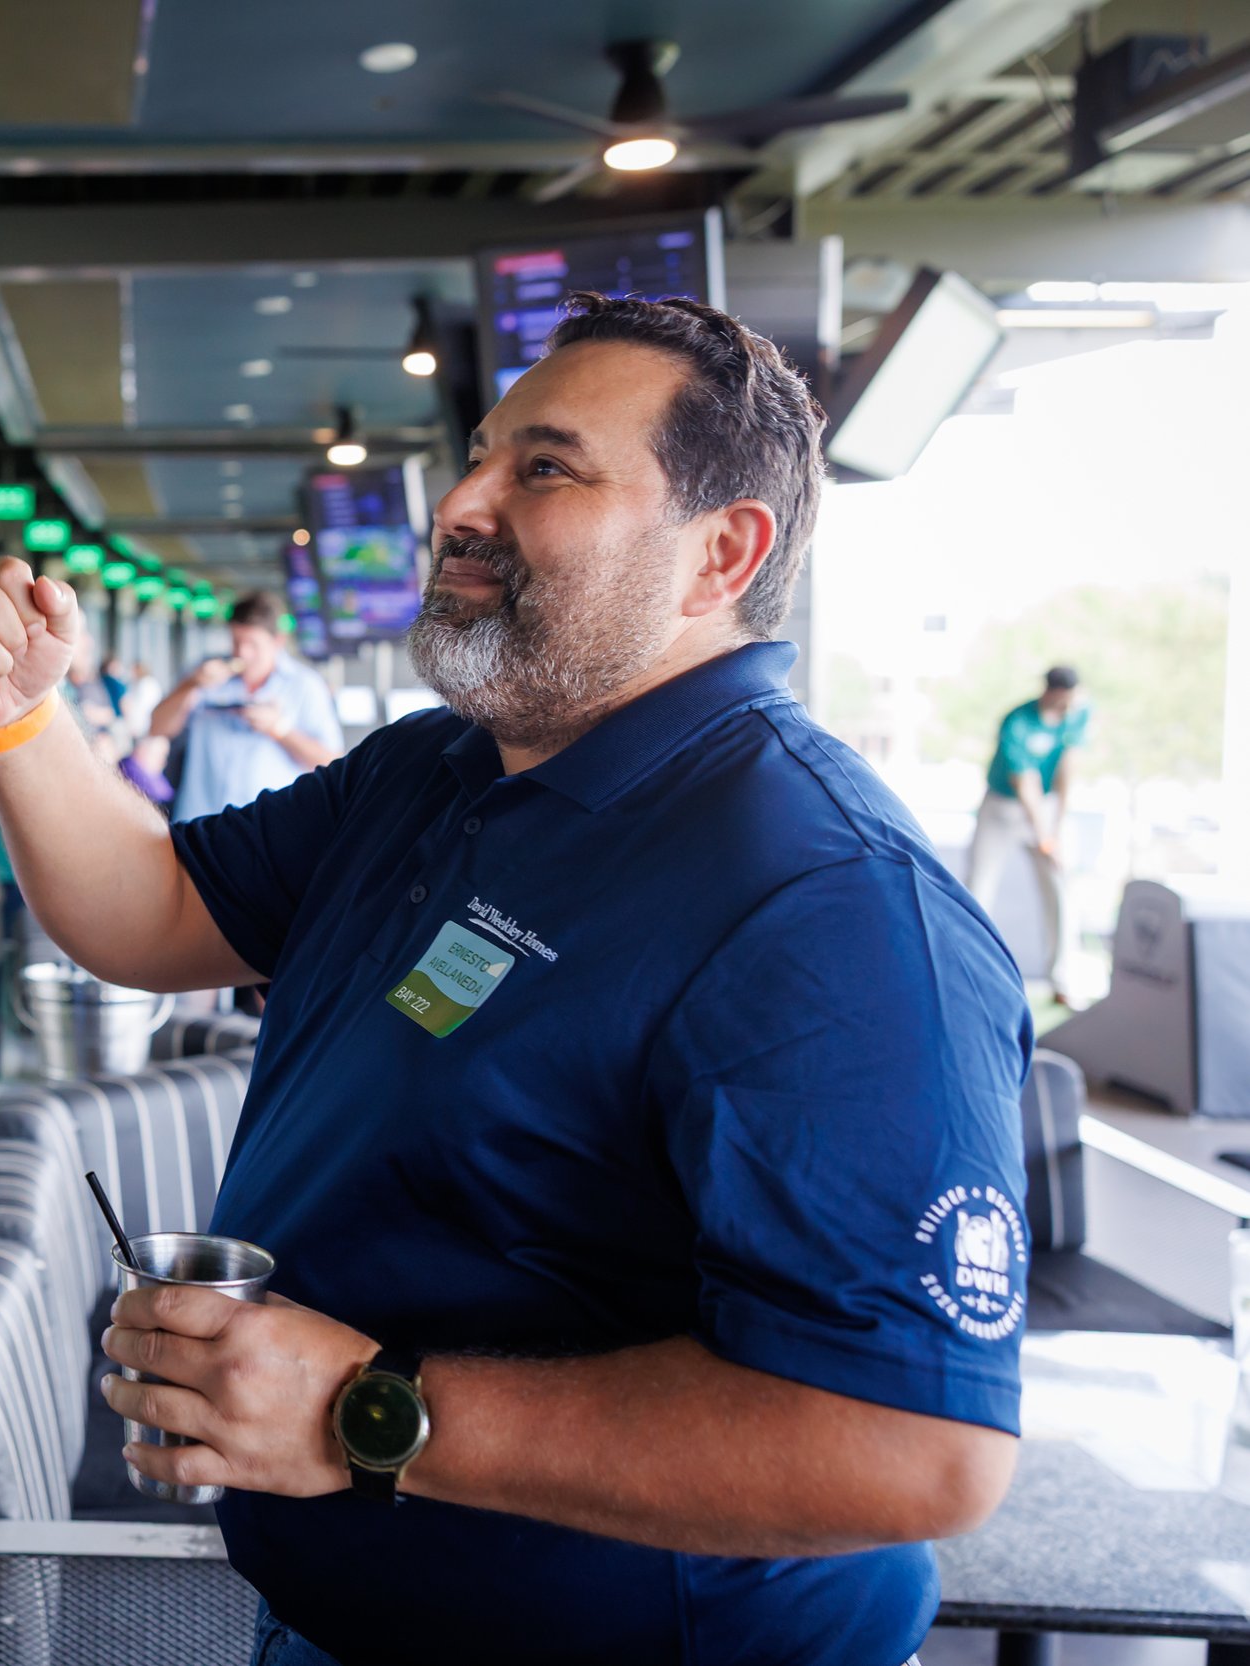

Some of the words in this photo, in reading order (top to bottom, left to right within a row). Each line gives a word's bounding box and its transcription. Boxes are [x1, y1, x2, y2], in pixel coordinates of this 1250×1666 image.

[467, 896, 492, 919] David
[488, 907, 523, 940] Weekley
[520, 930, 559, 962] Homes
[448, 942, 491, 973] ERNESTO
[427, 956, 484, 996] AVELLANEDA
[394, 986, 416, 1006] BAY:
[411, 996, 431, 1015] 222
[956, 1265, 1009, 1297] DWH
